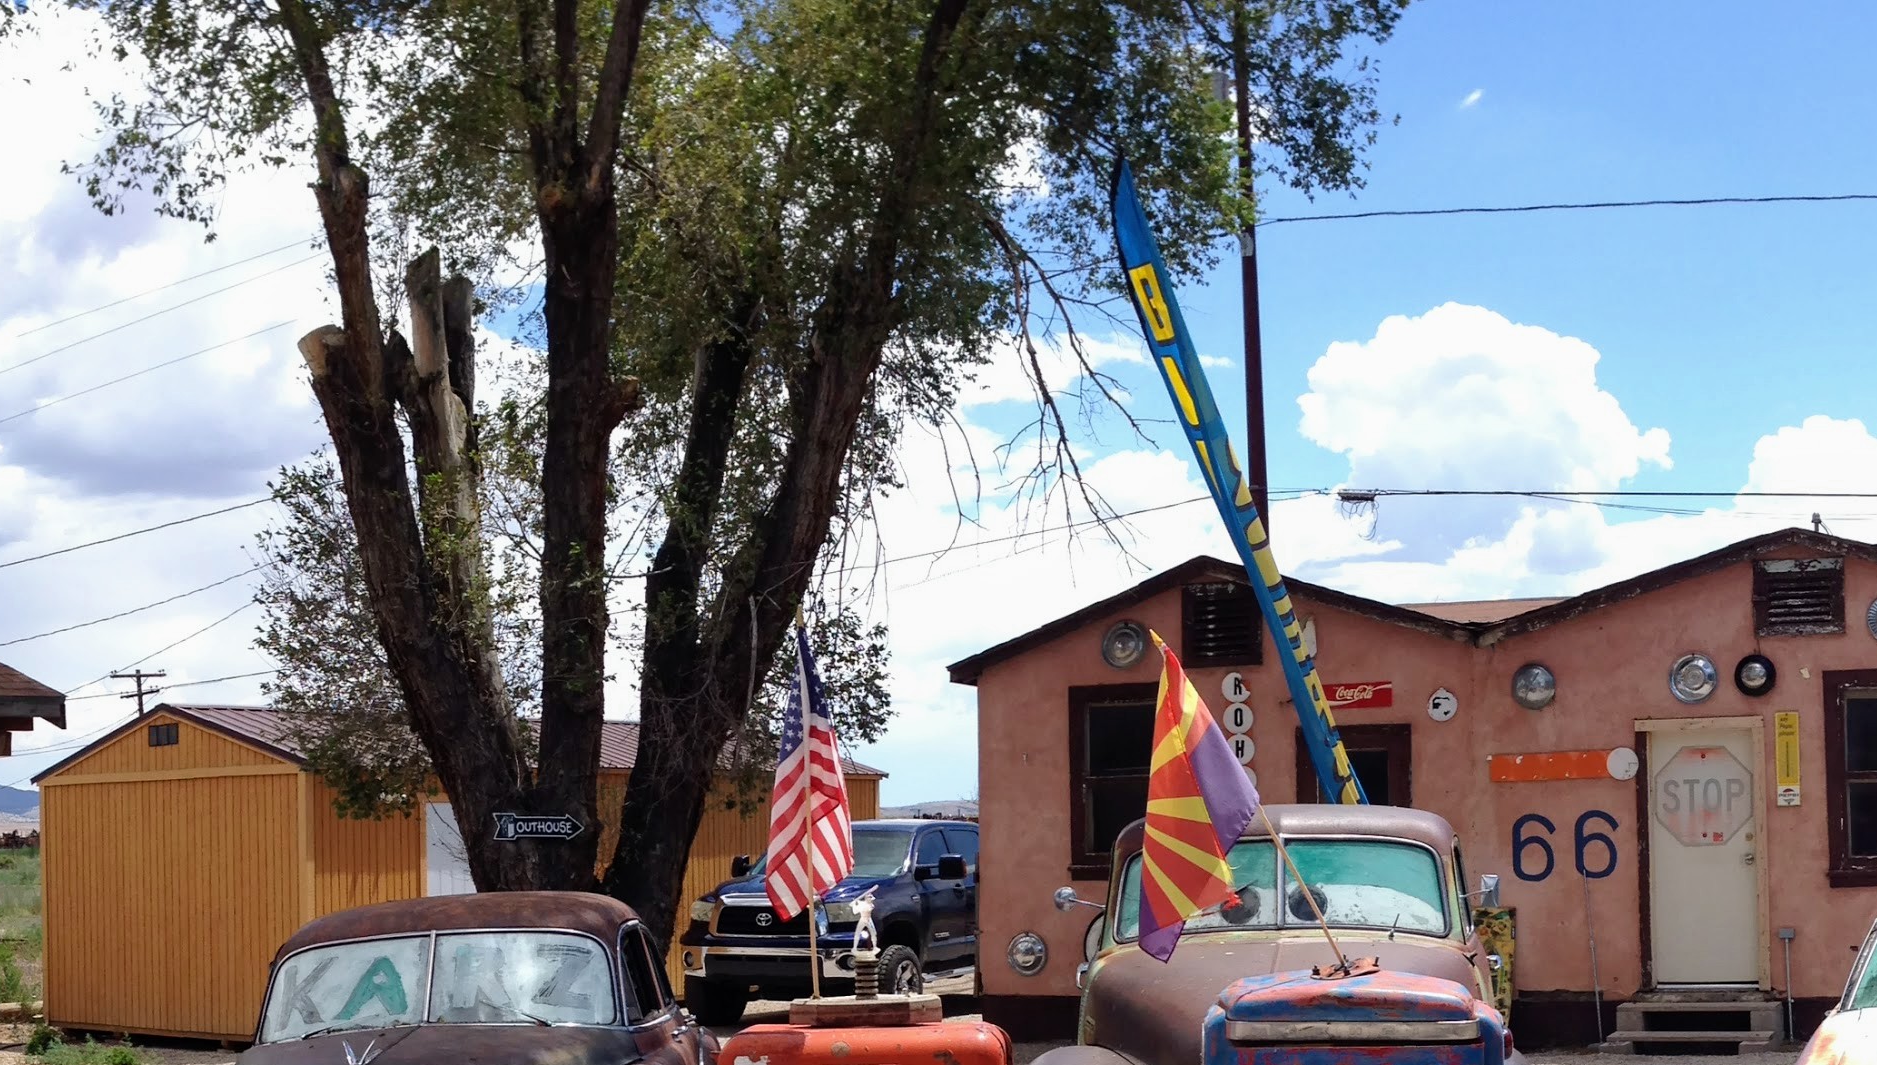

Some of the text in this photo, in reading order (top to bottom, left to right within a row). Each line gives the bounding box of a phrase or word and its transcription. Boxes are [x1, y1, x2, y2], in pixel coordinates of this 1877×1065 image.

[1662, 778, 1746, 815] STOP
[516, 820, 573, 834] OUTHOUSE
[1511, 809, 1620, 882] 66
